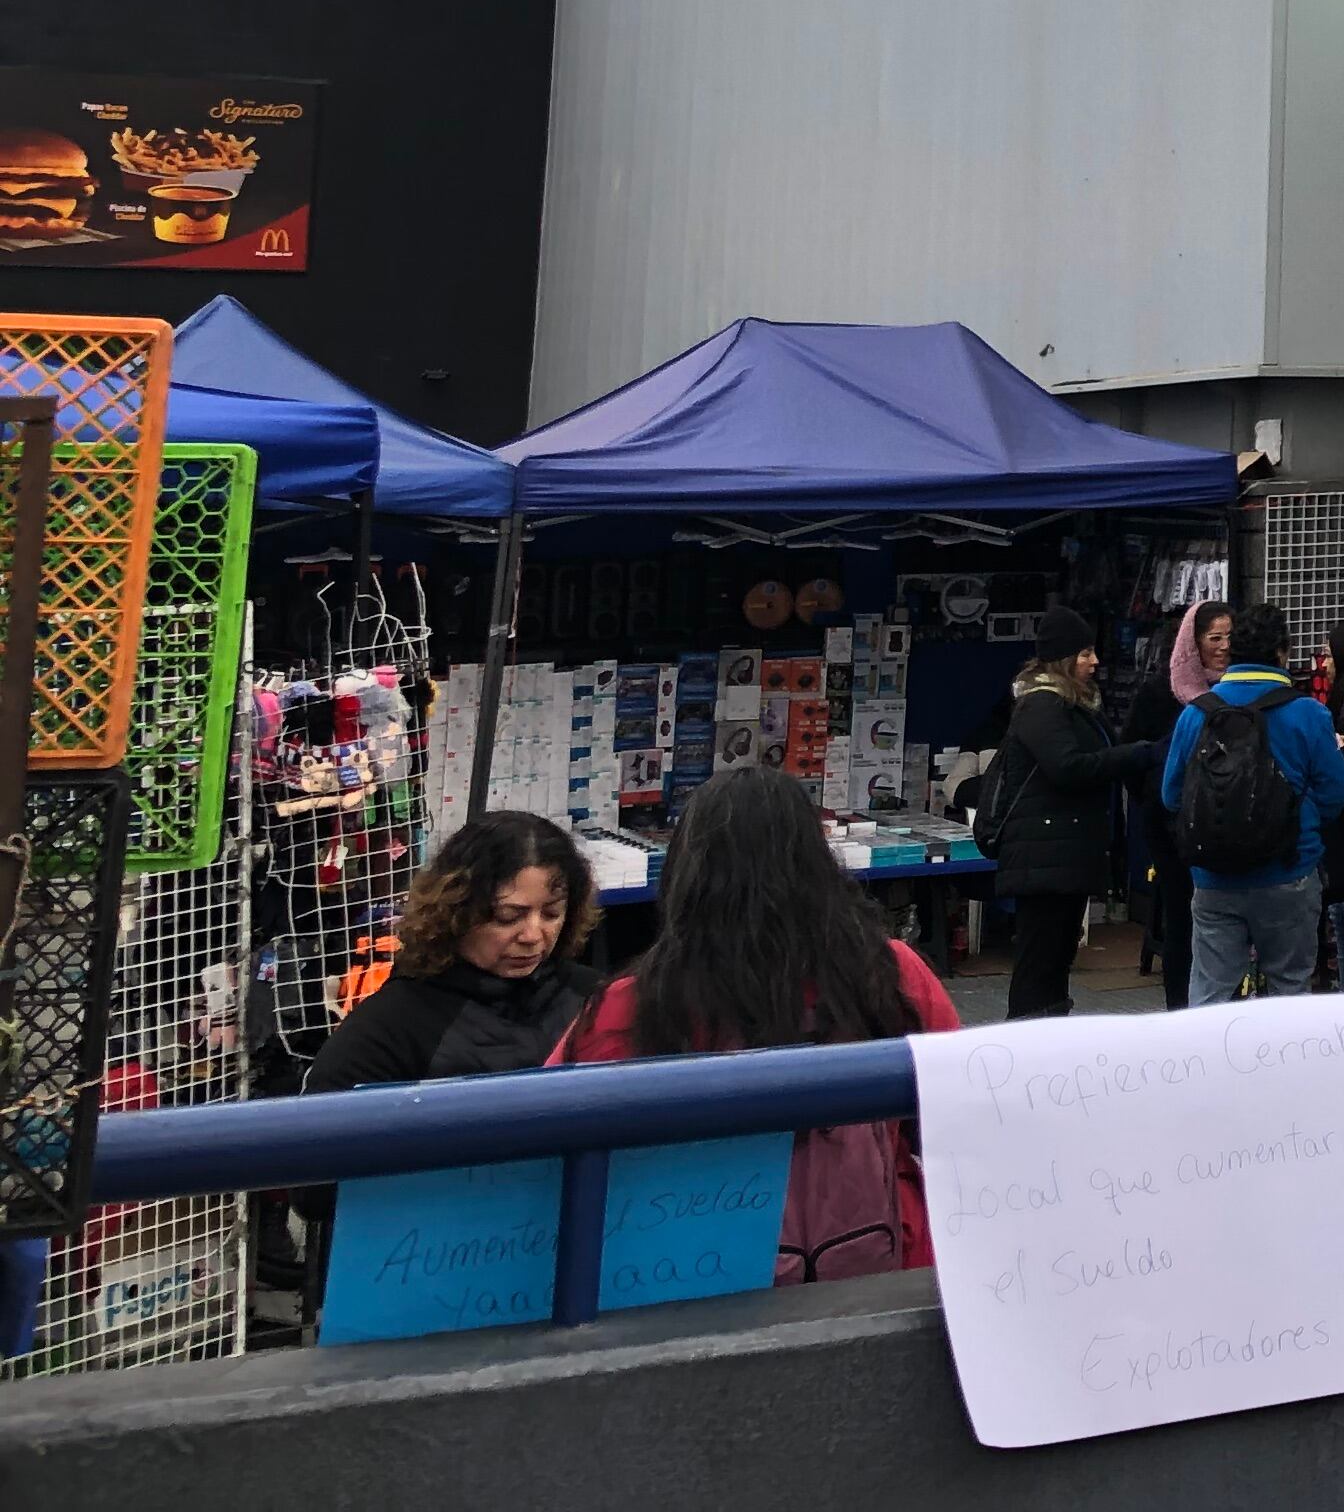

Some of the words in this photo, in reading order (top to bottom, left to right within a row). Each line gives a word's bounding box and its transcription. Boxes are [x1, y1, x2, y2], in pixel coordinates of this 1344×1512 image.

[209, 98, 303, 124] Signature
[966, 1043, 1208, 1126] Prefieren
[945, 1150, 1064, 1237] Local
[1088, 1167, 1161, 1216] que
[982, 1247, 1029, 1304] el
[1050, 1236, 1175, 1296] Sueldo
[1079, 1317, 1332, 1393] Explotadores
